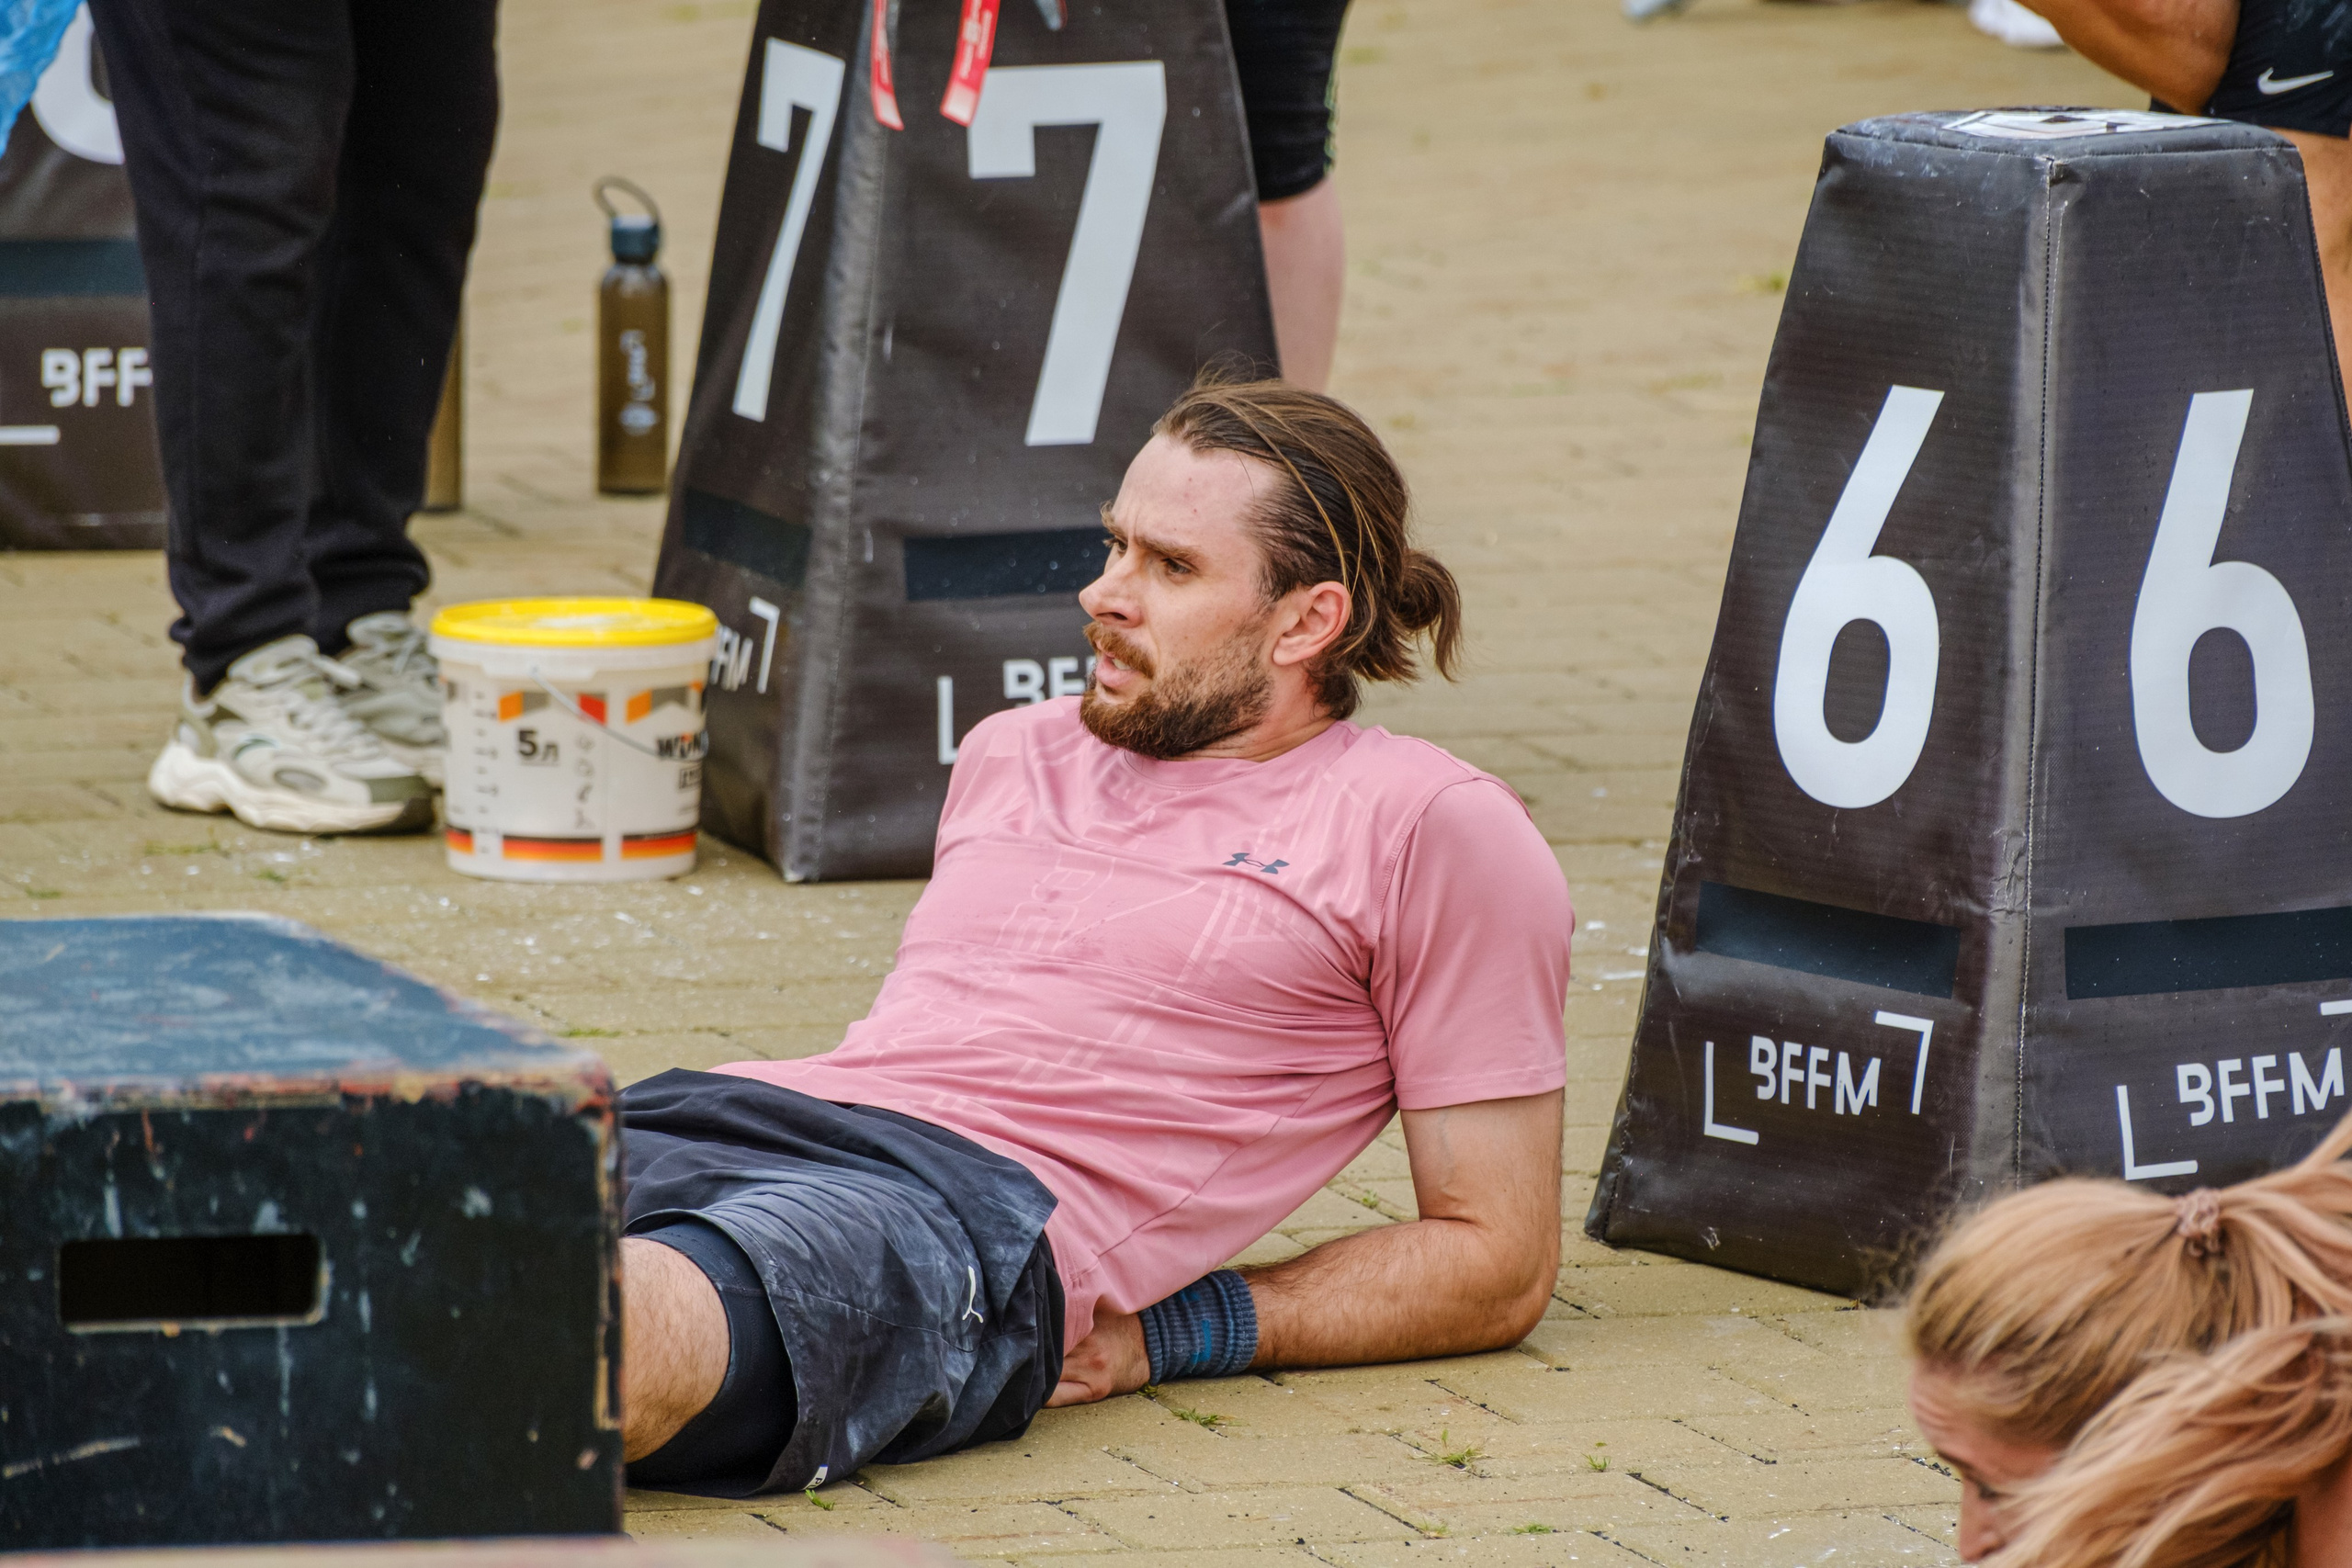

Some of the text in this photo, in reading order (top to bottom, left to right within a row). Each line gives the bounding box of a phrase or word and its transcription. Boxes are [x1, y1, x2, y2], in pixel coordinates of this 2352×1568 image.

[734, 37, 846, 422] 7
[967, 60, 1168, 446] 7
[41, 347, 153, 408] BFF
[1003, 656, 1097, 708] BF
[1773, 384, 1945, 809] 6
[2130, 388, 2315, 818] 6
[1749, 1034, 1882, 1116] BFFM
[2176, 1047, 2345, 1127] BFFM
